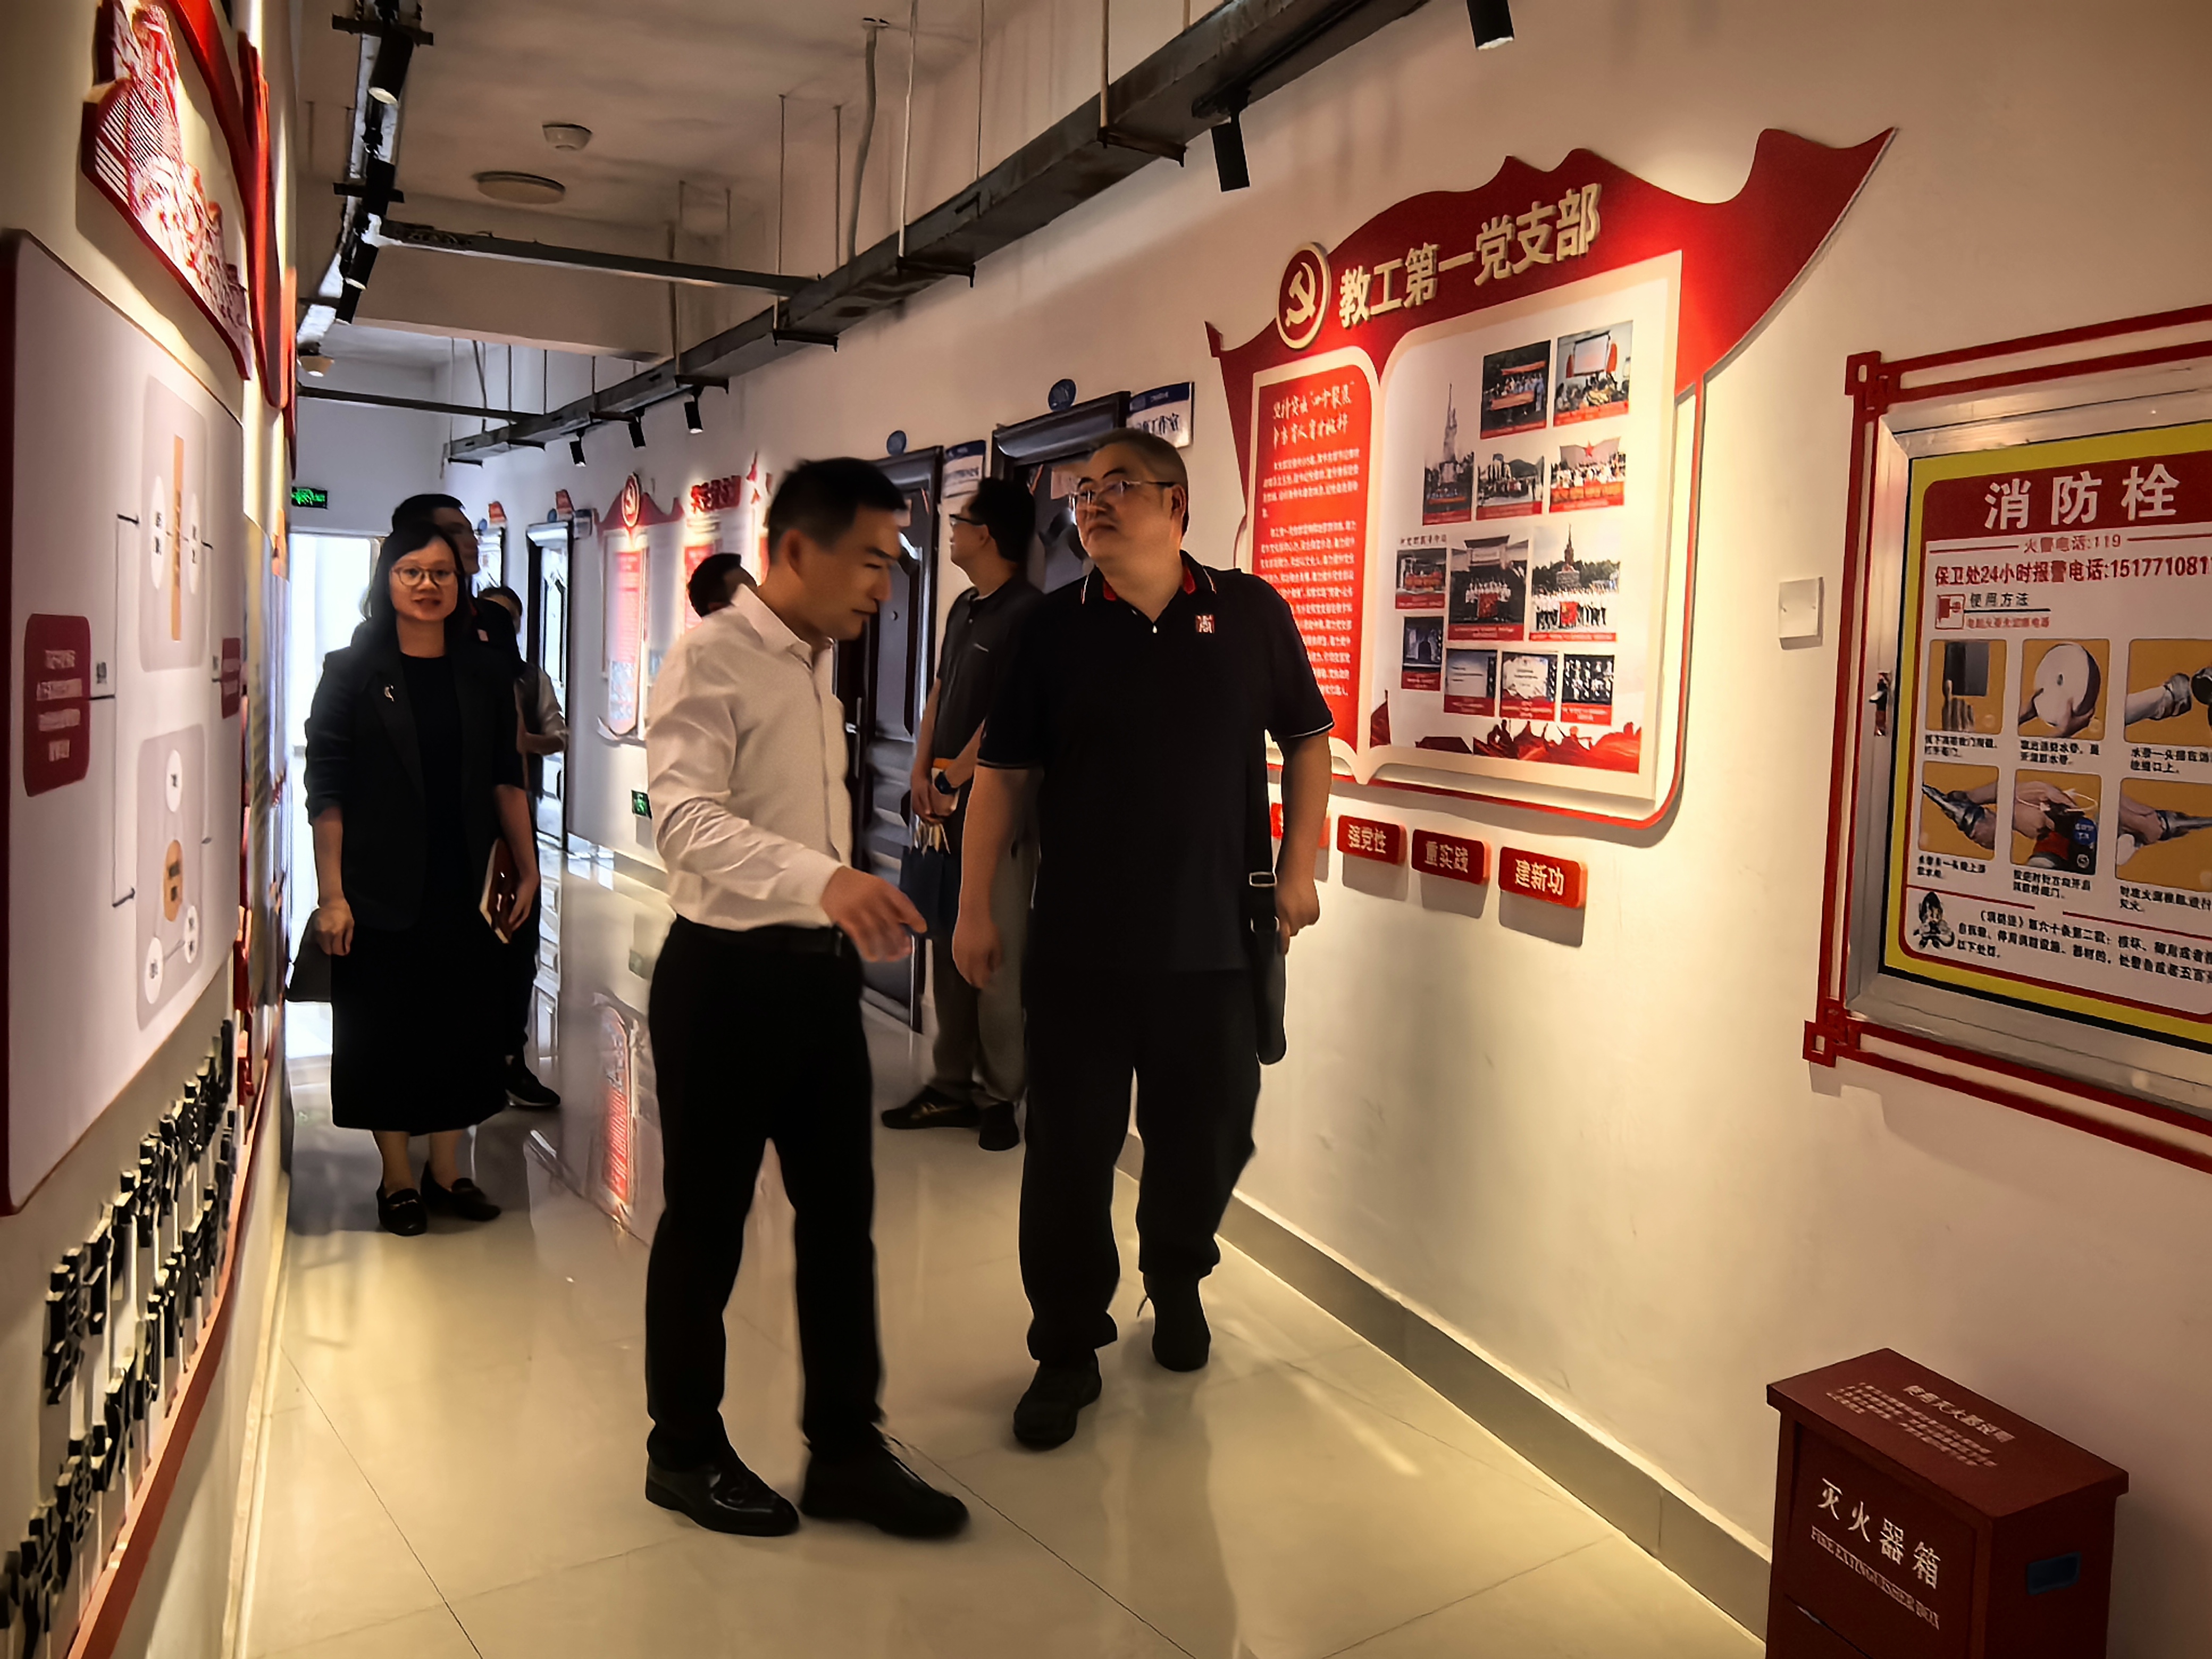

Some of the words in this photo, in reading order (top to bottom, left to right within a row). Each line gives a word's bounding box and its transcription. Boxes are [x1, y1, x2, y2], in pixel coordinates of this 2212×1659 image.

[1339, 183, 1602, 329] 教工第一党支部
[1984, 463, 2180, 531] 消防栓
[1935, 556, 2212, 586] 保卫处24小时报警电话:151771081
[1970, 592, 2030, 608] 使用方法
[1425, 840, 1468, 873] 重实践
[1515, 858, 1564, 895] 建新功
[1817, 1477, 1941, 1589] 灭火器箱
